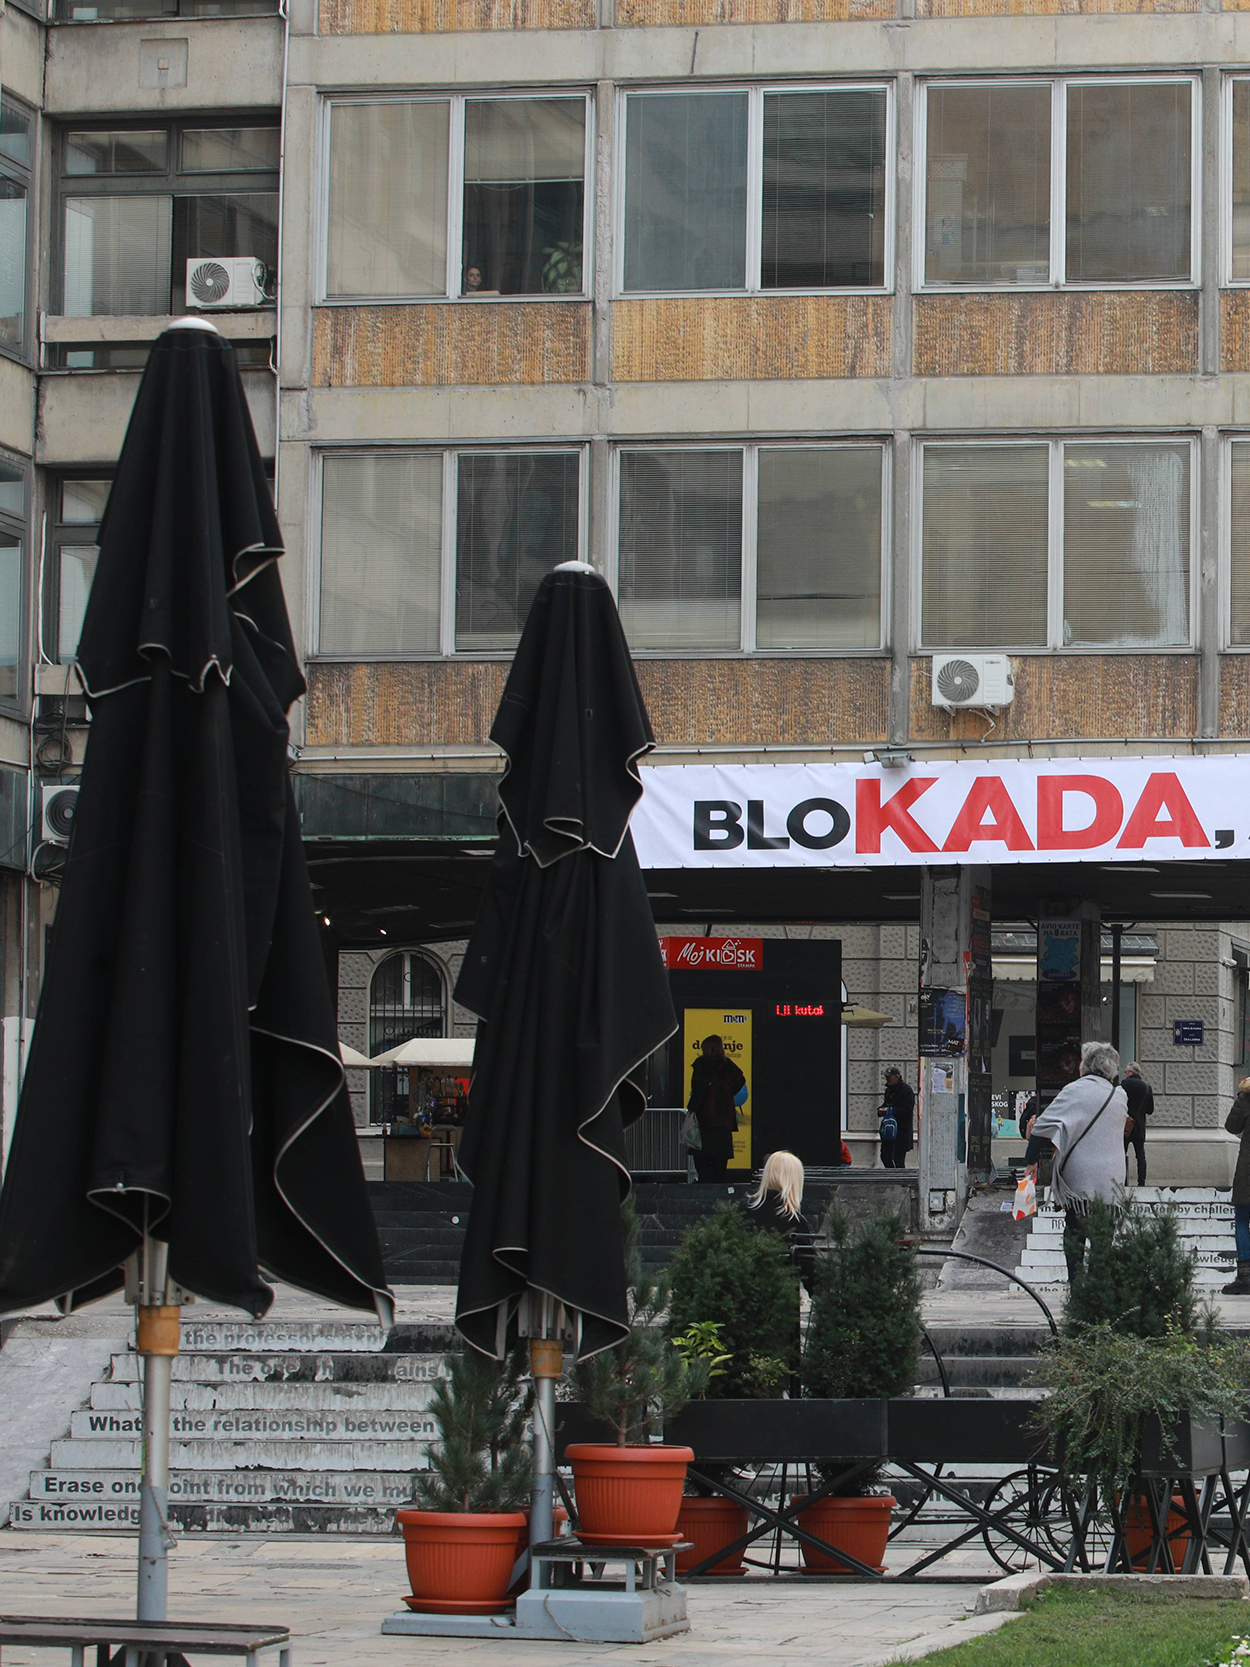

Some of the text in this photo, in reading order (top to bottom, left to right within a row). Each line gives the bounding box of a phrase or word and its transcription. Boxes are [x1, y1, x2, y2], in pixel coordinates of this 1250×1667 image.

[693, 772, 1236, 854] BLOKADA,
[677, 942, 704, 965] Moj
[185, 1329, 217, 1345] the
[89, 1416, 435, 1436] What the relationship between
[44, 1476, 104, 1493] Erase
[170, 1479, 211, 1495] oint
[217, 1479, 266, 1495] from
[273, 1480, 336, 1497] which
[343, 1484, 375, 1498] we
[15, 1505, 141, 1525] Is knowledg
